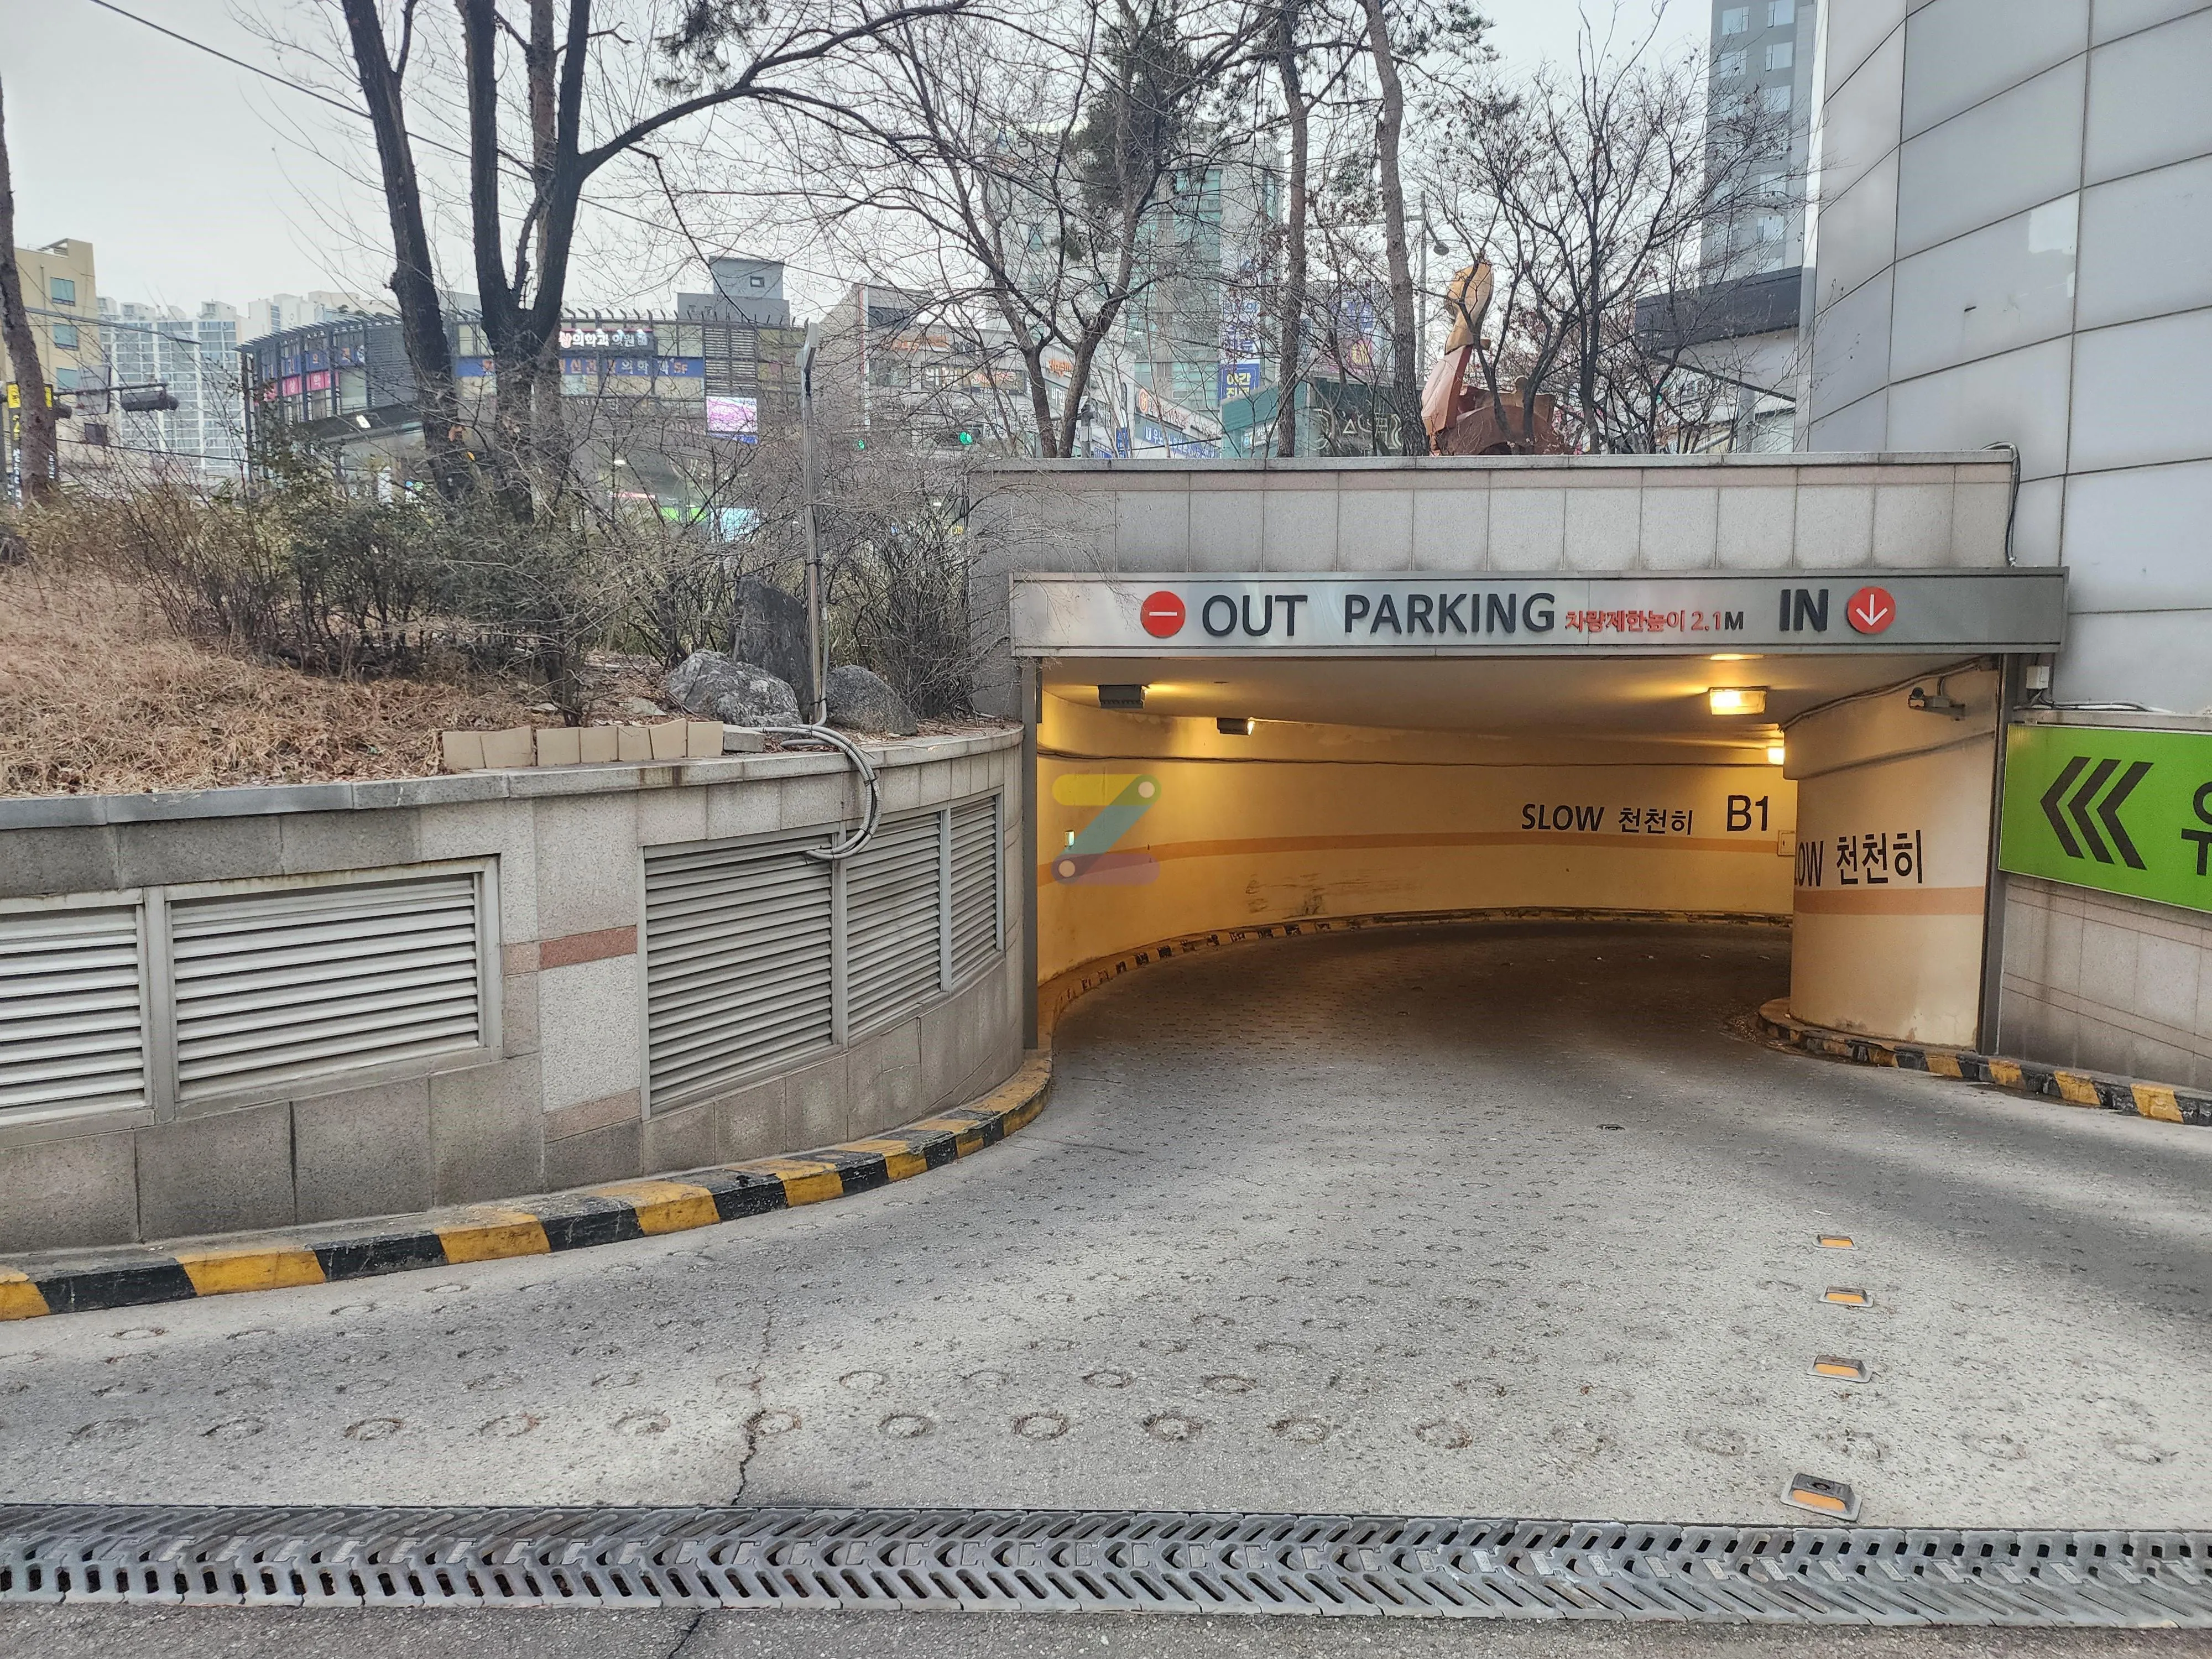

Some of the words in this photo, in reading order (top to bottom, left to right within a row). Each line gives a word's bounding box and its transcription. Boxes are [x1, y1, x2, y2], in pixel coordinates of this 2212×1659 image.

[1202, 594, 1308, 637] OUT
[1344, 592, 1555, 634] PARKING
[1565, 609, 1686, 633] 차량제한높이
[1691, 610, 1744, 631] 2.1M
[1779, 588, 1829, 632] IN
[1521, 803, 1605, 832] SLOW
[1618, 807, 1693, 836] 천천히
[1726, 795, 1769, 832] B1
[1795, 840, 1824, 886] OW
[1836, 829, 1923, 885] 천천히
